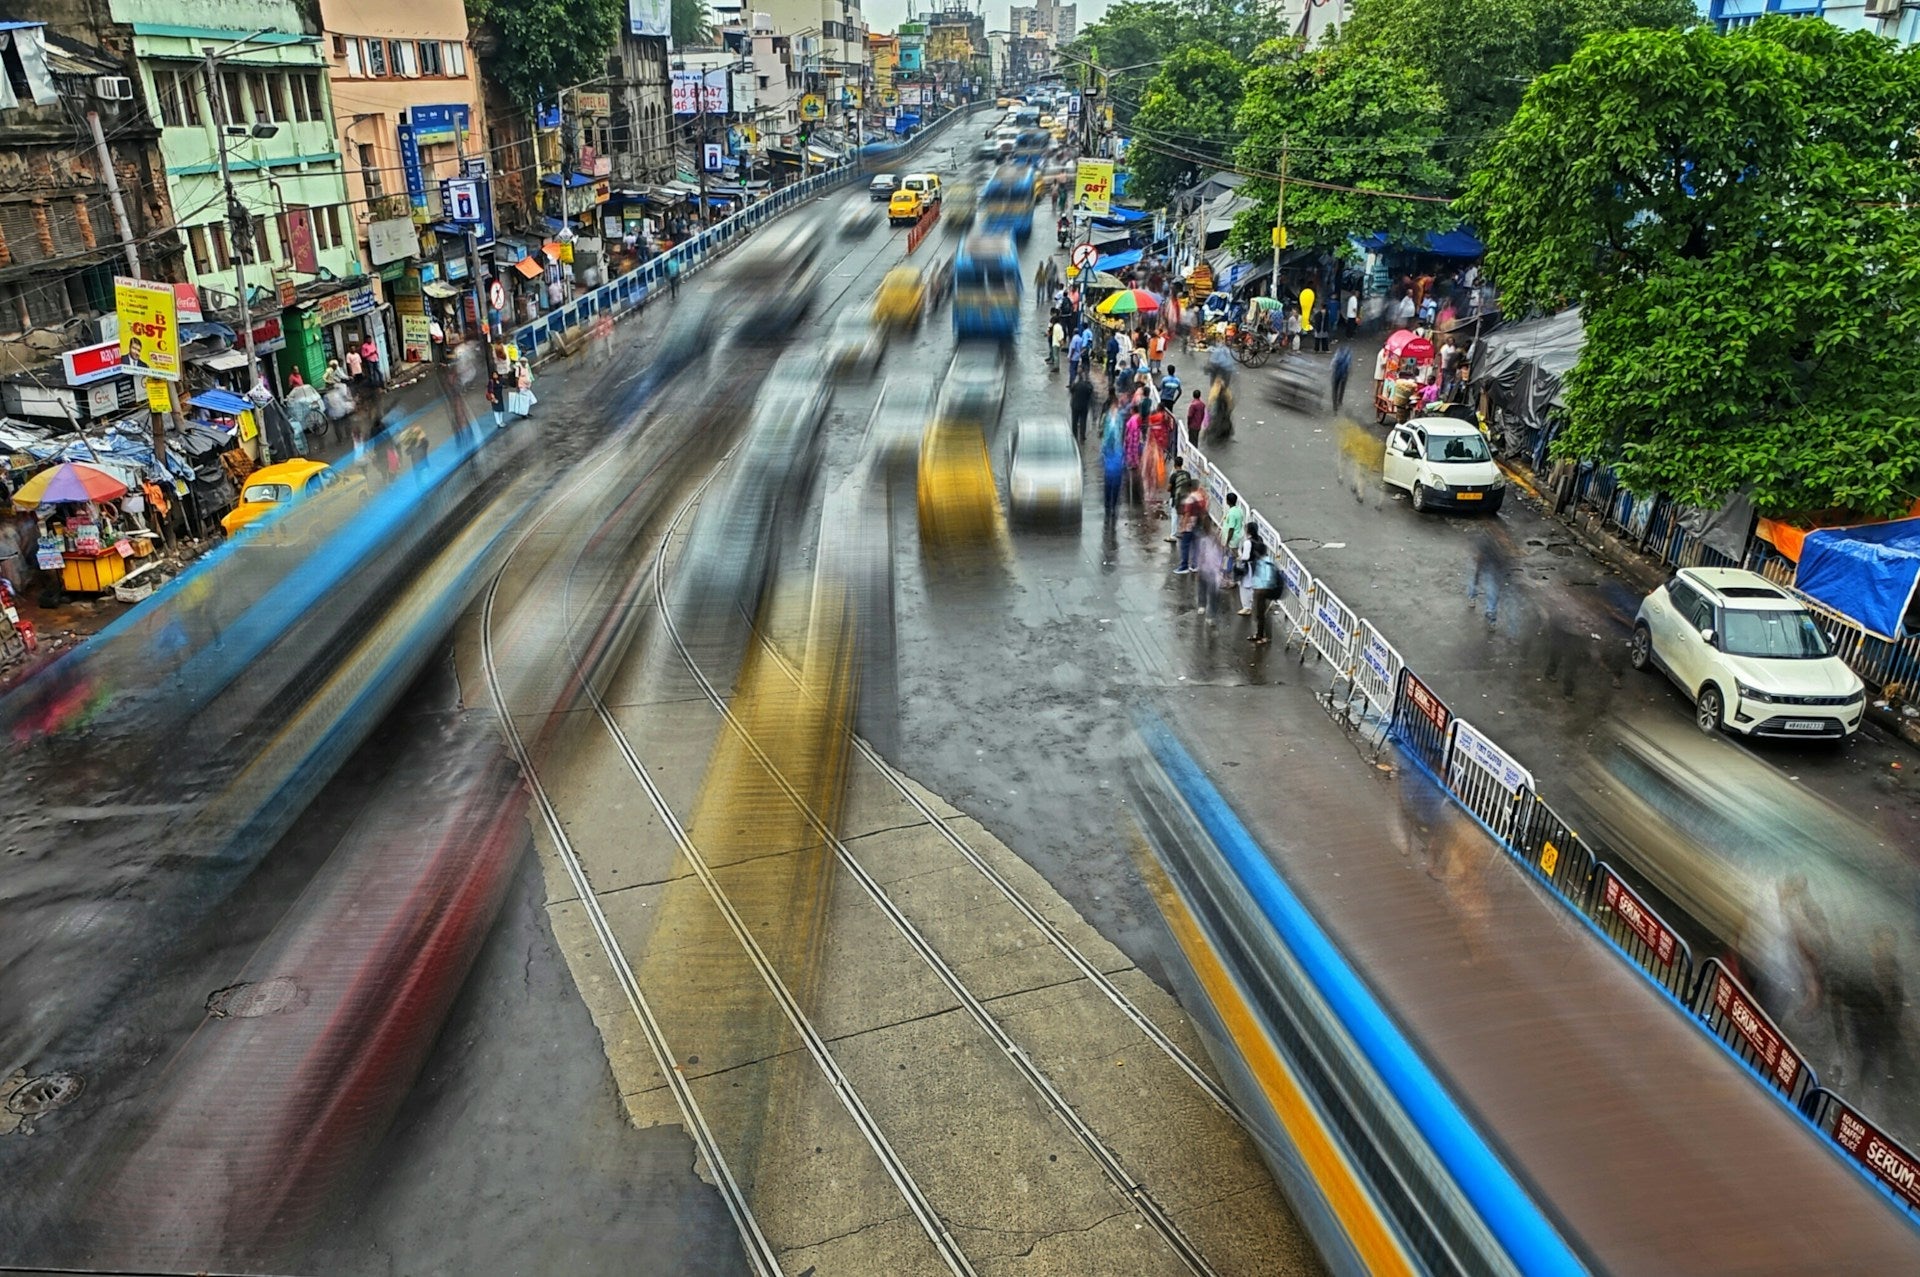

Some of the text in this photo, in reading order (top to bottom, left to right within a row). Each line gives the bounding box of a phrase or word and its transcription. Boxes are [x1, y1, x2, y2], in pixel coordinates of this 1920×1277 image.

[1084, 183, 1107, 193] GST
[155, 313, 166, 326] B
[132, 322, 167, 339] GST
[157, 340, 168, 351] C
[99, 347, 121, 366] Raym
[1618, 895, 1642, 928] SERUM
[1731, 1001, 1760, 1040] SERUM
[1779, 1057, 1794, 1078] TRAFFIC
[1781, 1048, 1797, 1070] KOLKATA
[1776, 1066, 1790, 1085] POLICE
[1840, 1122, 1863, 1145] TRAFFIC
[1842, 1113, 1866, 1137] KOLKATA
[1837, 1131, 1859, 1153] POLICE
[1867, 1141, 1915, 1190] SERUM
